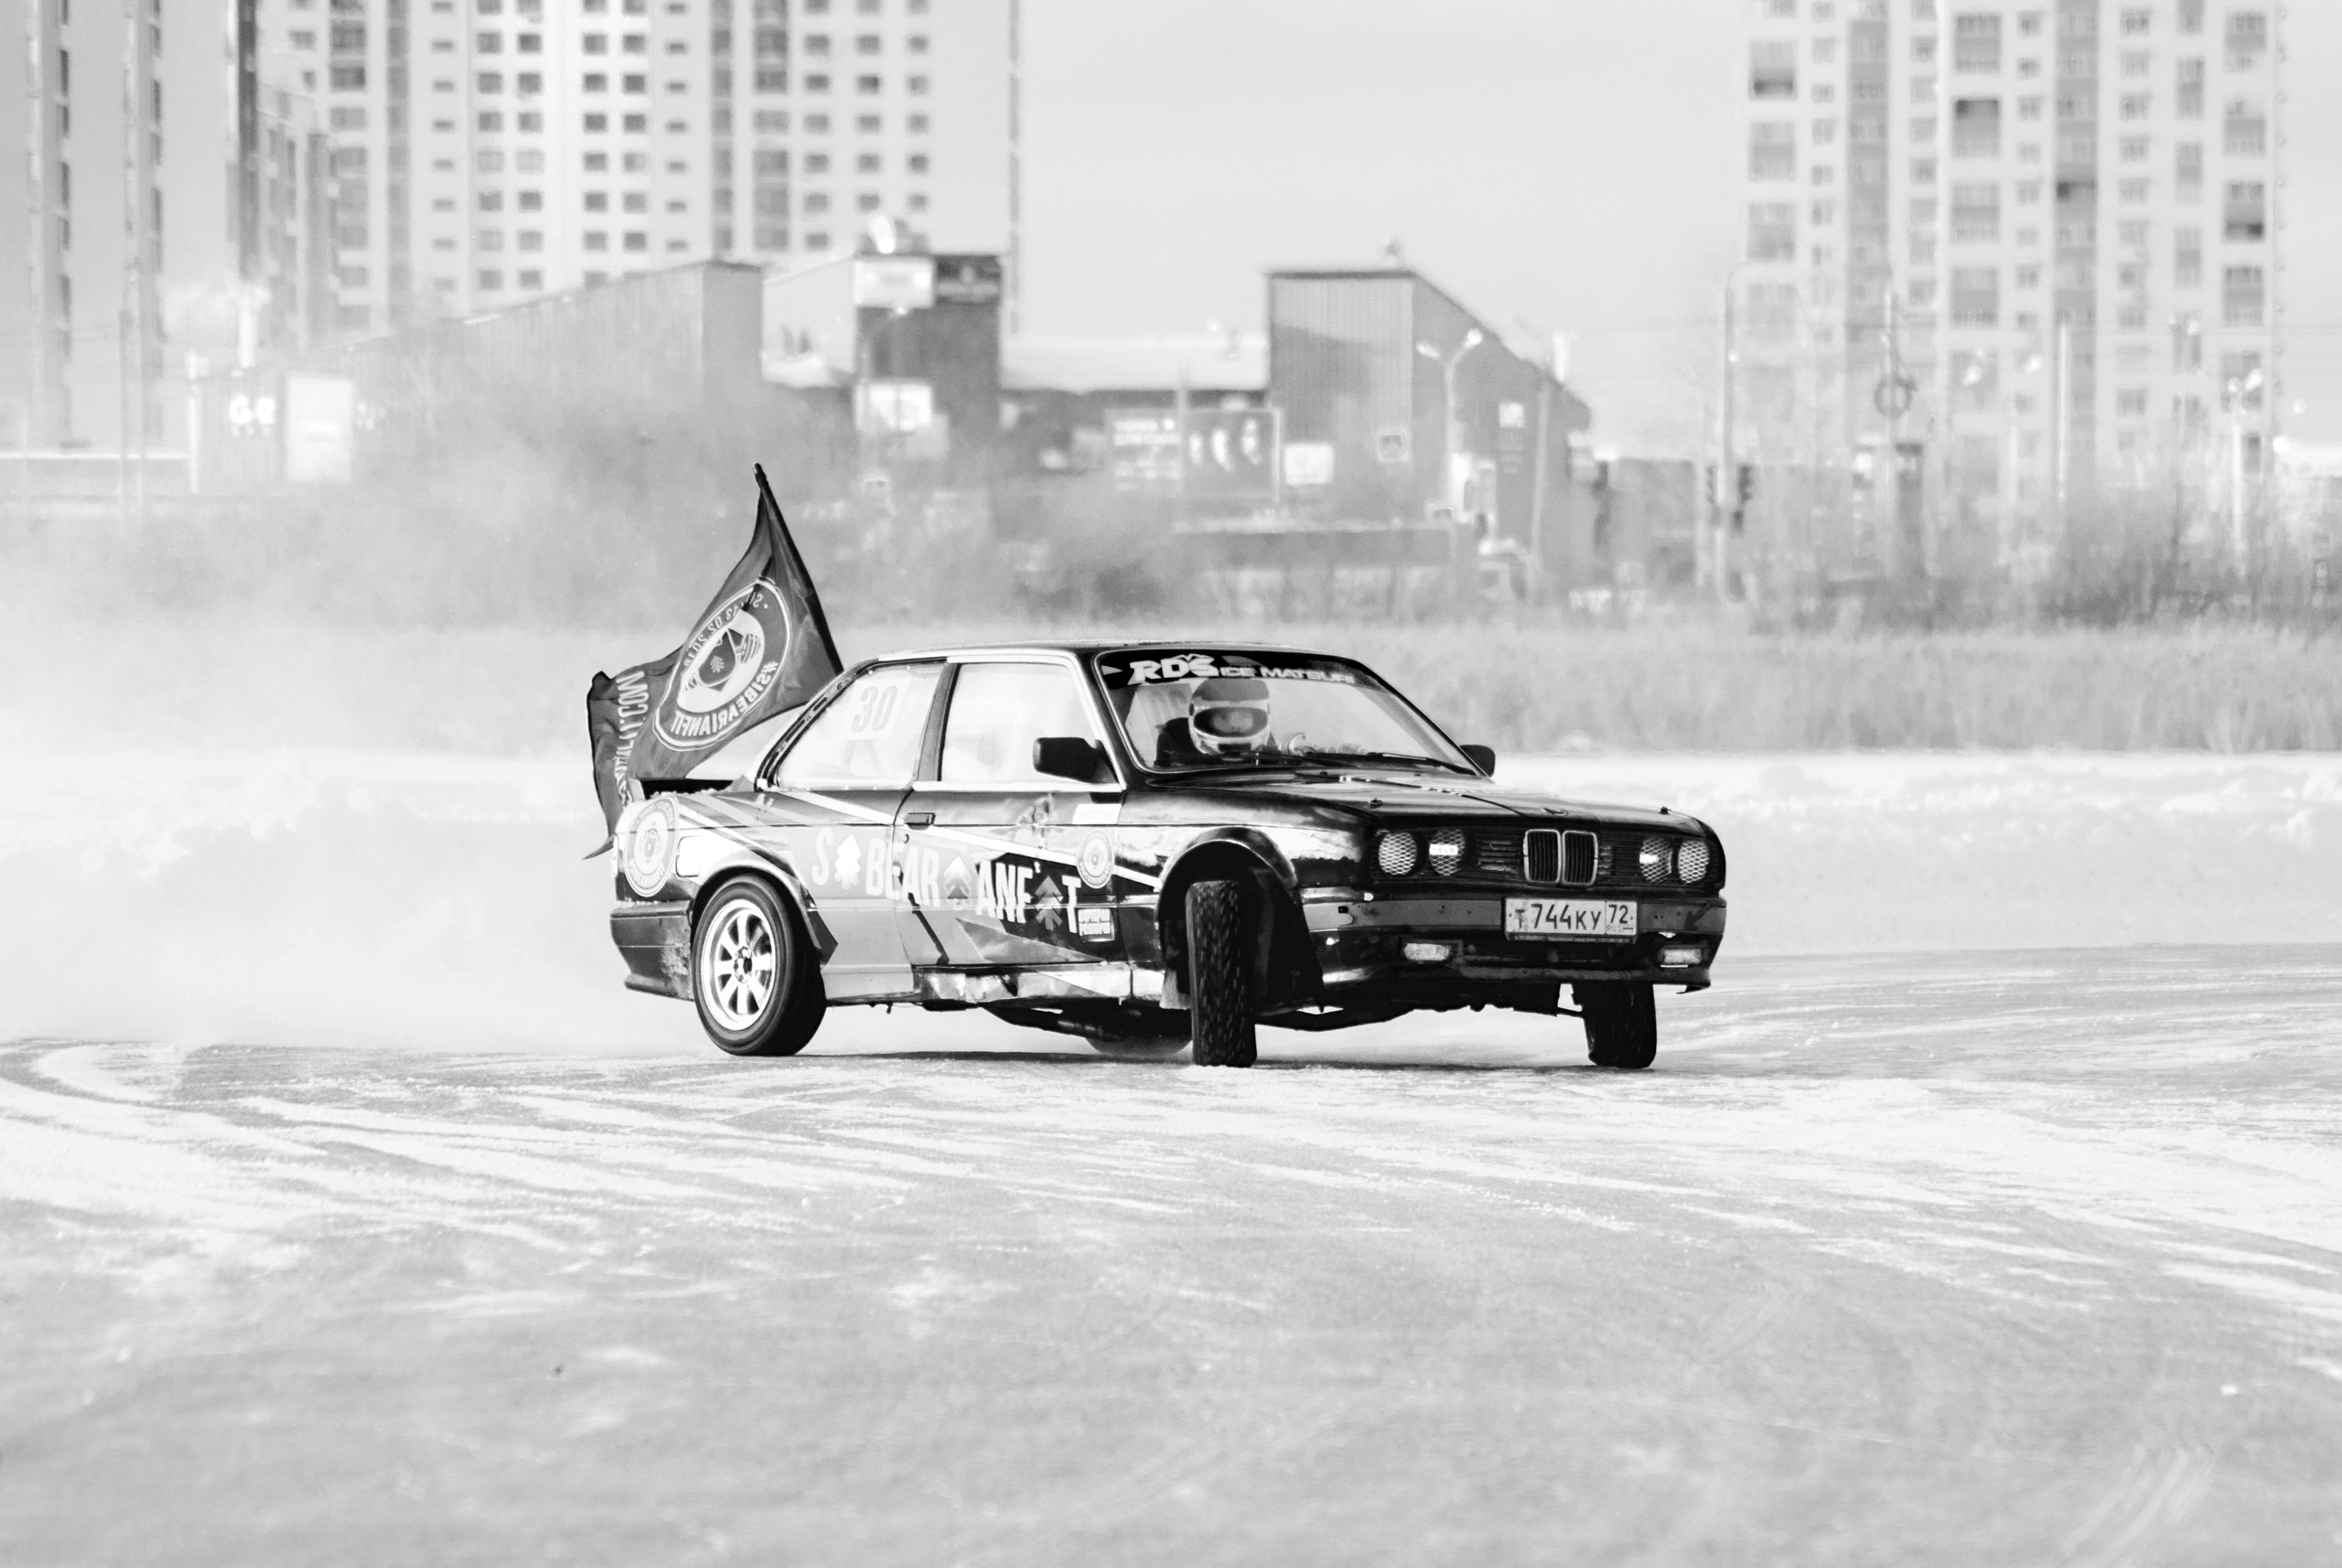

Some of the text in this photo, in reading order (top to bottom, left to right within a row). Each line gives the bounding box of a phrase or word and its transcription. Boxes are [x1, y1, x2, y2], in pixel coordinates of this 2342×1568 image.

[1220, 666, 1257, 678] ICE
[1260, 667, 1356, 684] MATSURI
[851, 684, 898, 734] 30
[1606, 924, 1622, 932] RUS
